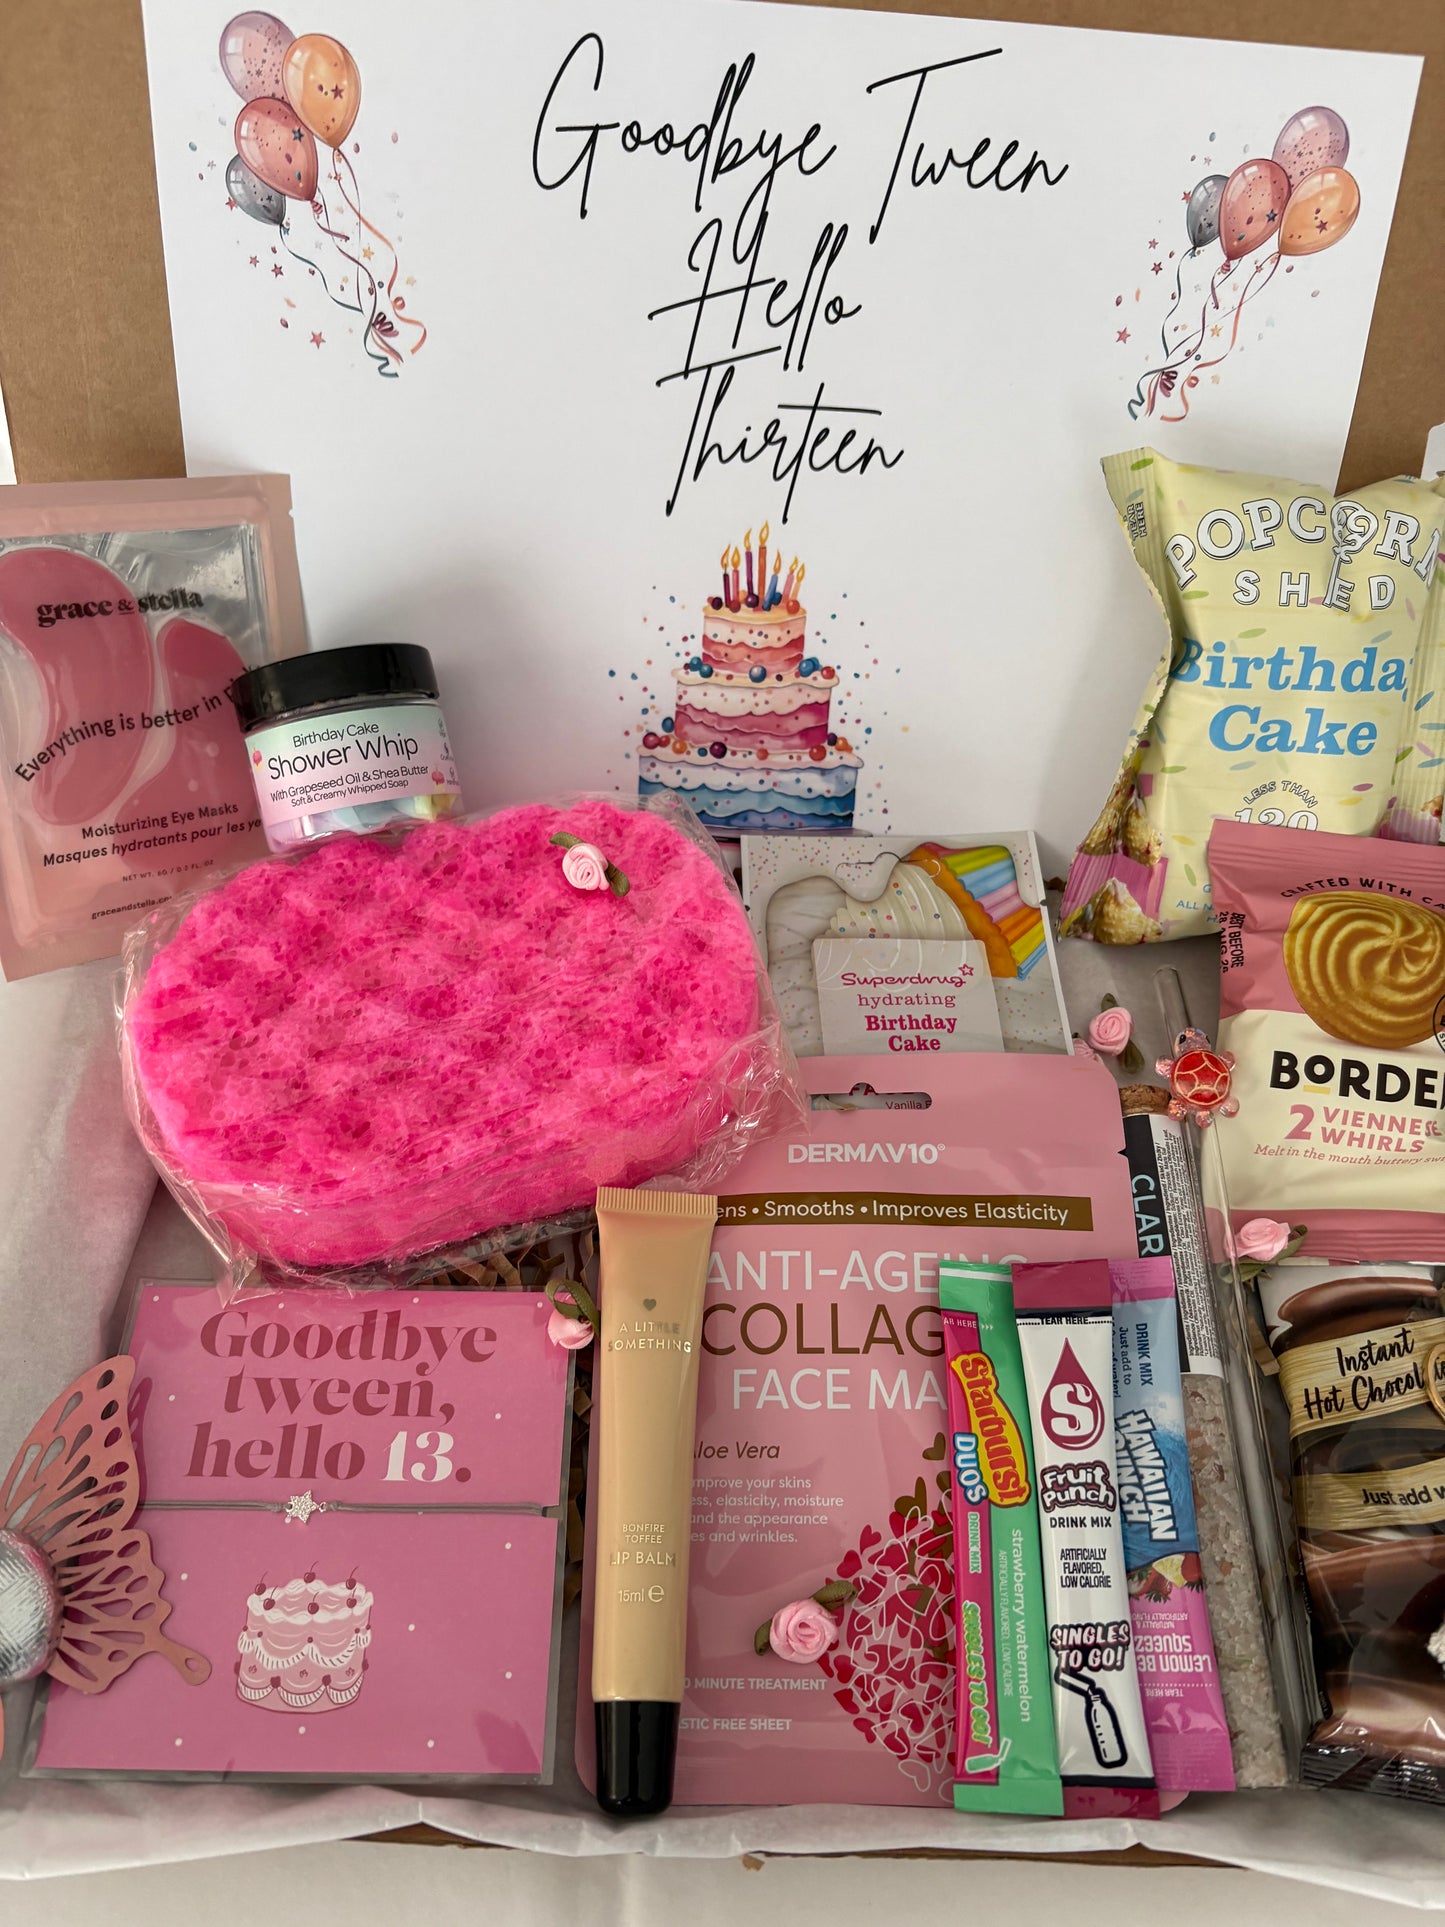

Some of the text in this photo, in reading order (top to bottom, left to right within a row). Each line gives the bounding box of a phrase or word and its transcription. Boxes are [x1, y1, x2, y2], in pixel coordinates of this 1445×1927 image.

[533, 32, 1069, 264] Goodbye Tween
[648, 210, 863, 379] Hello
[656, 346, 904, 524] Thirteen
[1135, 502, 1147, 538] HERE
[1233, 569, 1396, 612] SHED
[37, 586, 204, 628] grace & stella
[1171, 637, 1413, 702] Birthda
[15, 694, 223, 782] Everything is better in
[293, 722, 380, 748] Birthday Cake
[1208, 704, 1378, 755] Cake
[268, 733, 419, 780] Shower Whip
[270, 765, 429, 802] With Grapeseed Oil & Shea Butter
[291, 796, 307, 807] Soft
[313, 789, 348, 803] Creamy
[347, 782, 387, 796] Whipped
[388, 778, 409, 790] Soap
[1243, 780, 1318, 808] LESS THAN
[82, 803, 239, 839] Moisturizing Eye Masks
[43, 818, 262, 867] Masques hydratants pour les ye
[1280, 877, 1412, 898] CRAFTED WITH
[1176, 900, 1198, 910] ALL
[1229, 931, 1245, 968] BEFORE
[840, 971, 967, 988] Superdrug
[857, 993, 956, 1009] hydrating
[865, 1014, 958, 1034] Birthday
[888, 1035, 941, 1052] Cake
[1270, 1050, 1445, 1110] BORDE
[885, 1100, 922, 1110] Vanilla
[1284, 1104, 1443, 1141] 2 VIENNESE
[1320, 1126, 1425, 1153] WHIRLS
[1254, 1144, 1422, 1166] Melt in the mouth buttery
[716, 1200, 1068, 1225] ens Smooths Improves Elasticity
[1131, 1174, 1165, 1256] CLAR
[619, 1322, 628, 1333] A
[701, 1302, 943, 1357] COLLAG
[957, 1318, 978, 1329] HERE
[1040, 1316, 1089, 1325] TEAR HERE
[200, 1309, 498, 1375] Goodbye
[608, 1338, 692, 1353] SOMETHING
[1135, 1323, 1153, 1386] DRINK MIX
[1336, 1328, 1414, 1376] Instant
[1119, 1327, 1132, 1386] Just add to
[224, 1364, 456, 1427] tween,
[733, 1368, 948, 1410] FACE MA
[1304, 1385, 1344, 1419] Hot
[960, 1356, 1027, 1501] Starburst
[185, 1421, 472, 1484] hello 13.
[693, 1441, 780, 1459] loe Vera
[955, 1433, 987, 1502] DUOS
[1043, 1465, 1106, 1489] Fruit
[1115, 1409, 1178, 1542] HAWAIIAN
[692, 1476, 811, 1495] mprove your skins
[1362, 1488, 1395, 1505] Just
[1398, 1486, 1432, 1506] add
[715, 1495, 844, 1509] elasticity, moisture
[622, 1523, 665, 1533] BONFIRE
[718, 1512, 828, 1529] the appearance
[1050, 1516, 1112, 1528] DRINK MIX
[625, 1533, 662, 1544] TOFFEE
[709, 1530, 798, 1543] and wrinkles.
[968, 1512, 981, 1573] DRINK MIX
[610, 1551, 676, 1566] LIP BALM
[1060, 1548, 1107, 1560] ARTIFICIALLY
[1063, 1561, 1105, 1575] FLAVORED,
[617, 1586, 645, 1602] 15ml
[1061, 1576, 1111, 1588] LOW CALORIE
[1011, 1528, 1033, 1722] strawberry watermelon
[1050, 1625, 1130, 1647] SINGLES
[962, 1601, 985, 1679] SINGLES
[1134, 1633, 1192, 1653] SQUEEZ
[1058, 1648, 1125, 1669] TO GO!
[1136, 1654, 1156, 1672] BE
[694, 1677, 745, 1690] MINUTE
[747, 1678, 827, 1690] TREATMENT
[968, 1681, 988, 1706] TO
[1145, 1689, 1184, 1697] TEAR HERE
[679, 1718, 792, 1730] STIC FREE SHEET
